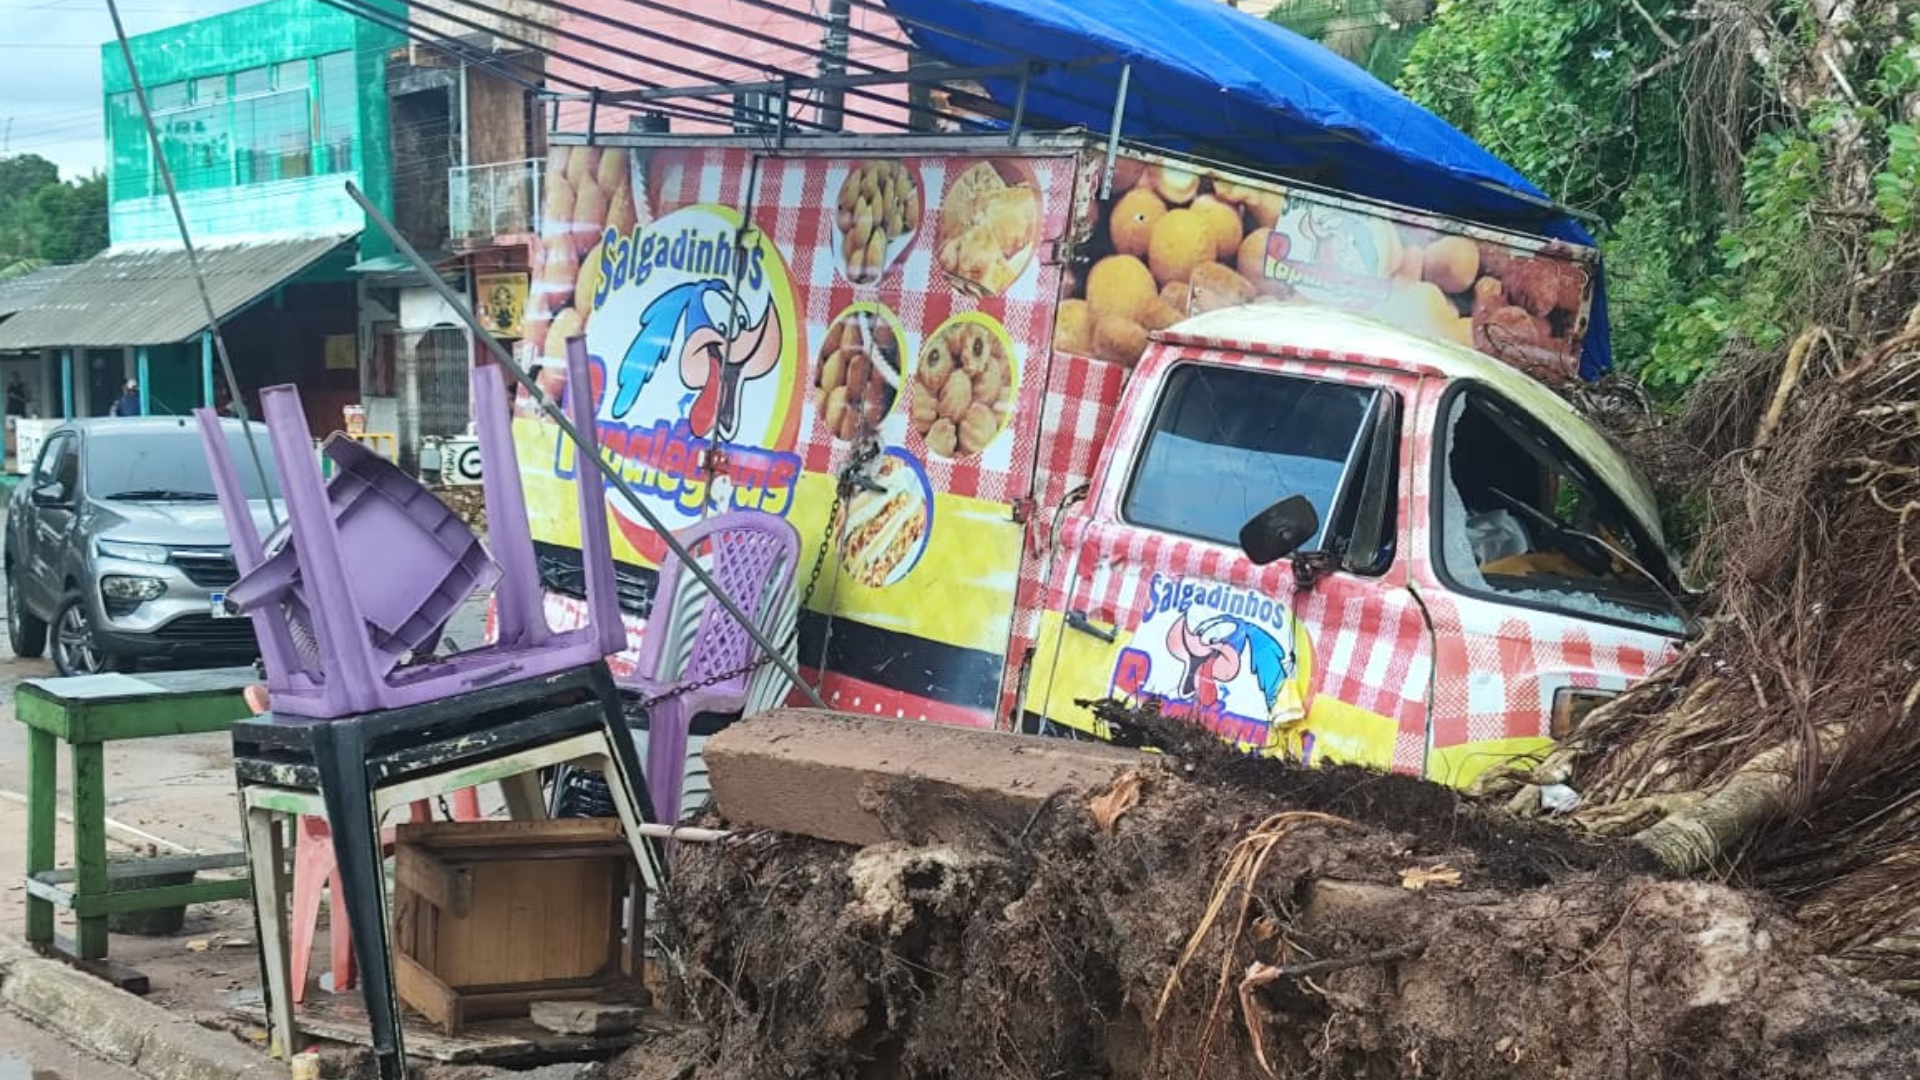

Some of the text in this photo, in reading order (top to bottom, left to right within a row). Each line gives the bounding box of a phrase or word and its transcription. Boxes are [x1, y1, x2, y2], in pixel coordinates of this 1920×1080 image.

[594, 227, 765, 309] Salgadinhos
[555, 355, 802, 518] Ppalégas
[1142, 573, 1286, 630] Salgadinhos
